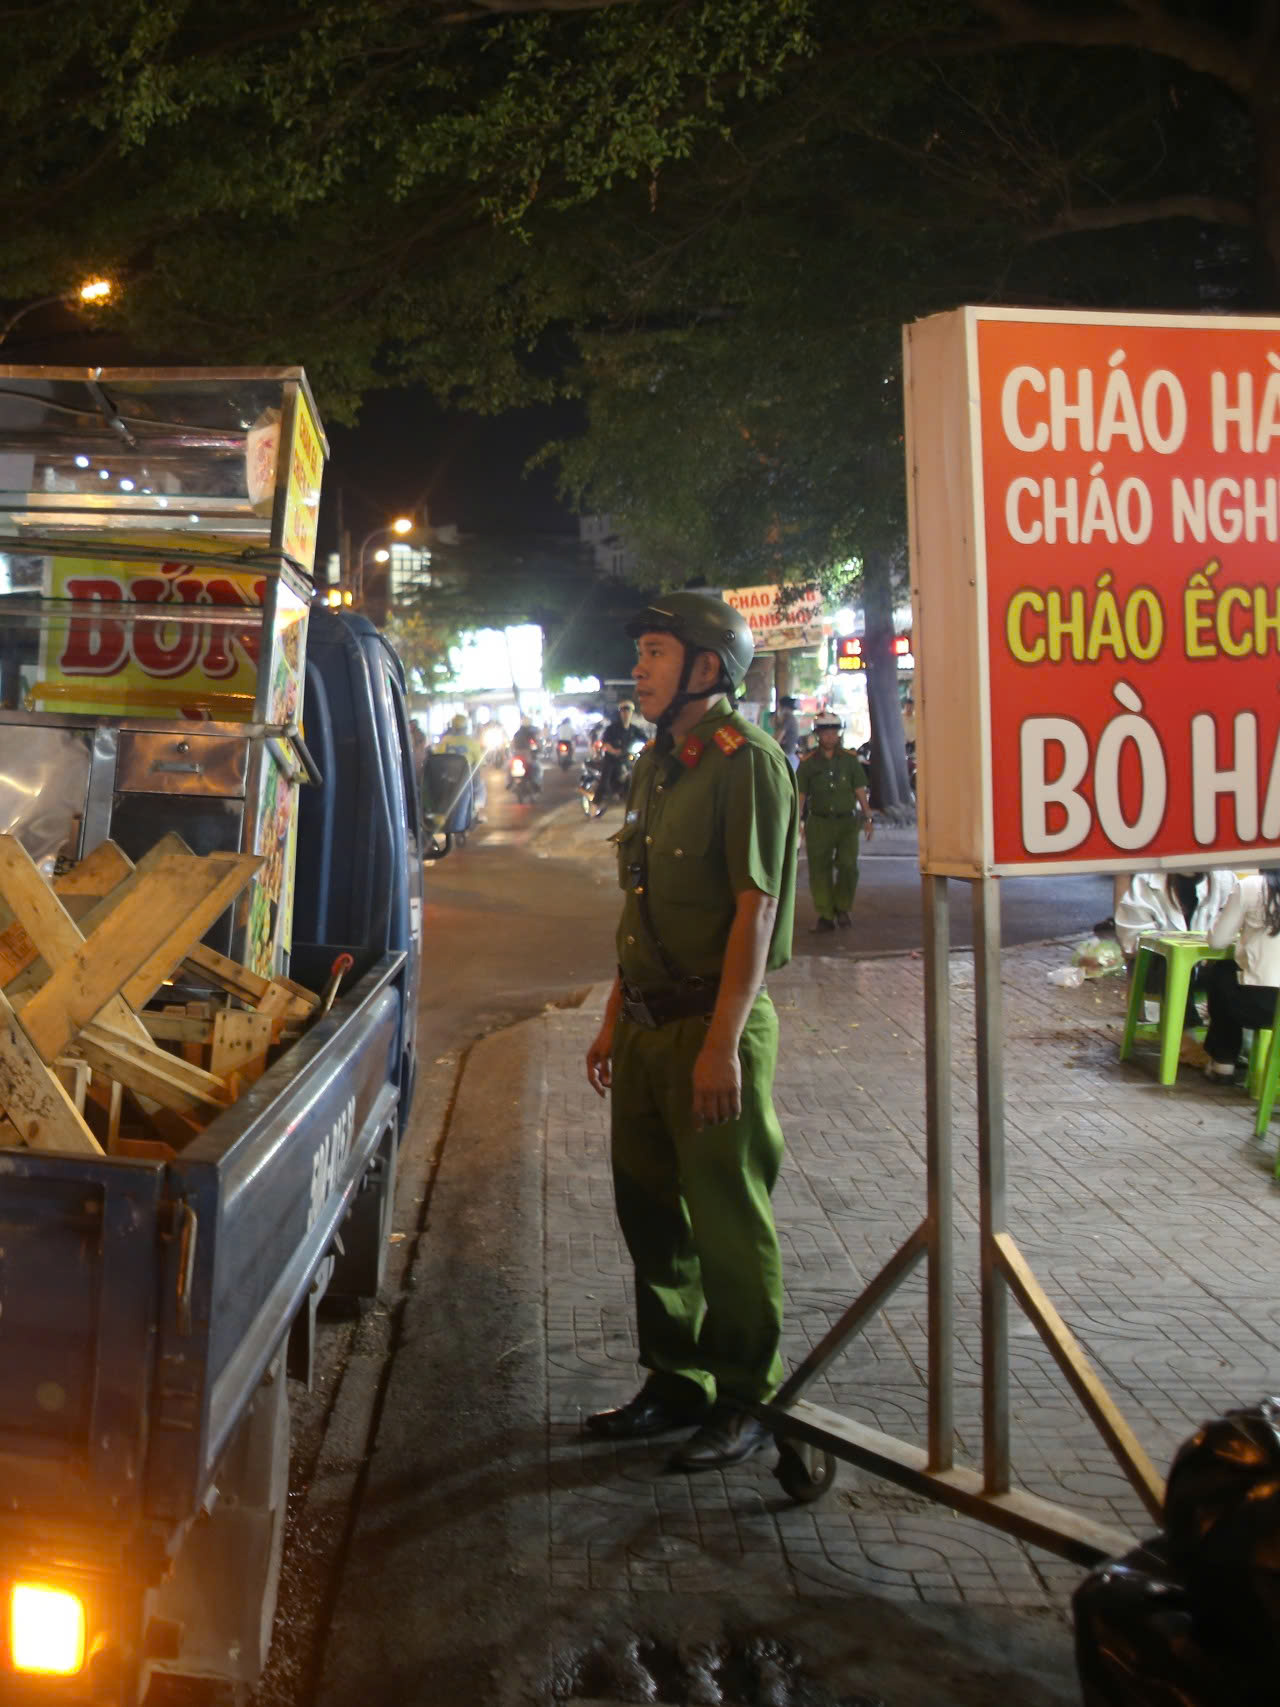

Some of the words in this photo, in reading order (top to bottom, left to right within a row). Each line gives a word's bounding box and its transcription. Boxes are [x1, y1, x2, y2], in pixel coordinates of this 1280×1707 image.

[1001, 349, 1187, 455] CHÁO
[1005, 461, 1153, 545] CHÁO
[1006, 572, 1164, 664] CHÁO
[1184, 561, 1280, 658] ẾCH
[1019, 680, 1167, 855] BÒ
